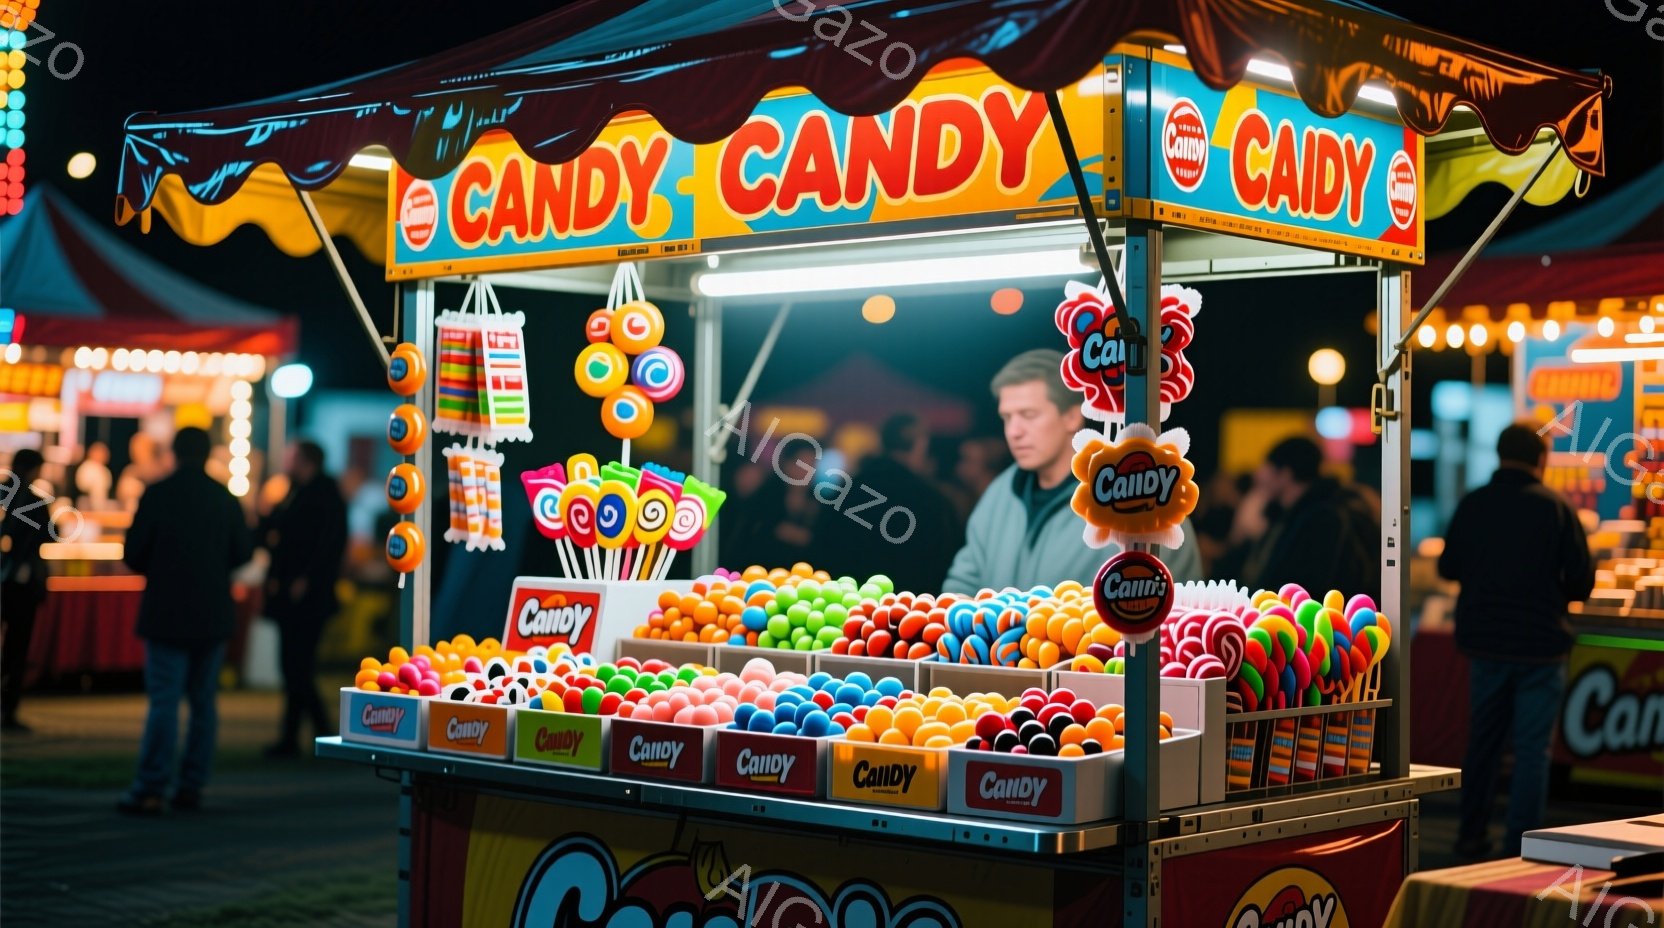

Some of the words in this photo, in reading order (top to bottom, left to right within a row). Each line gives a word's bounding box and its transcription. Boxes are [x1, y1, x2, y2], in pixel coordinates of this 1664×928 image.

[449, 136, 670, 244] CANDY
[718, 90, 1050, 216] CANDY
[1232, 113, 1373, 224] CAIDY
